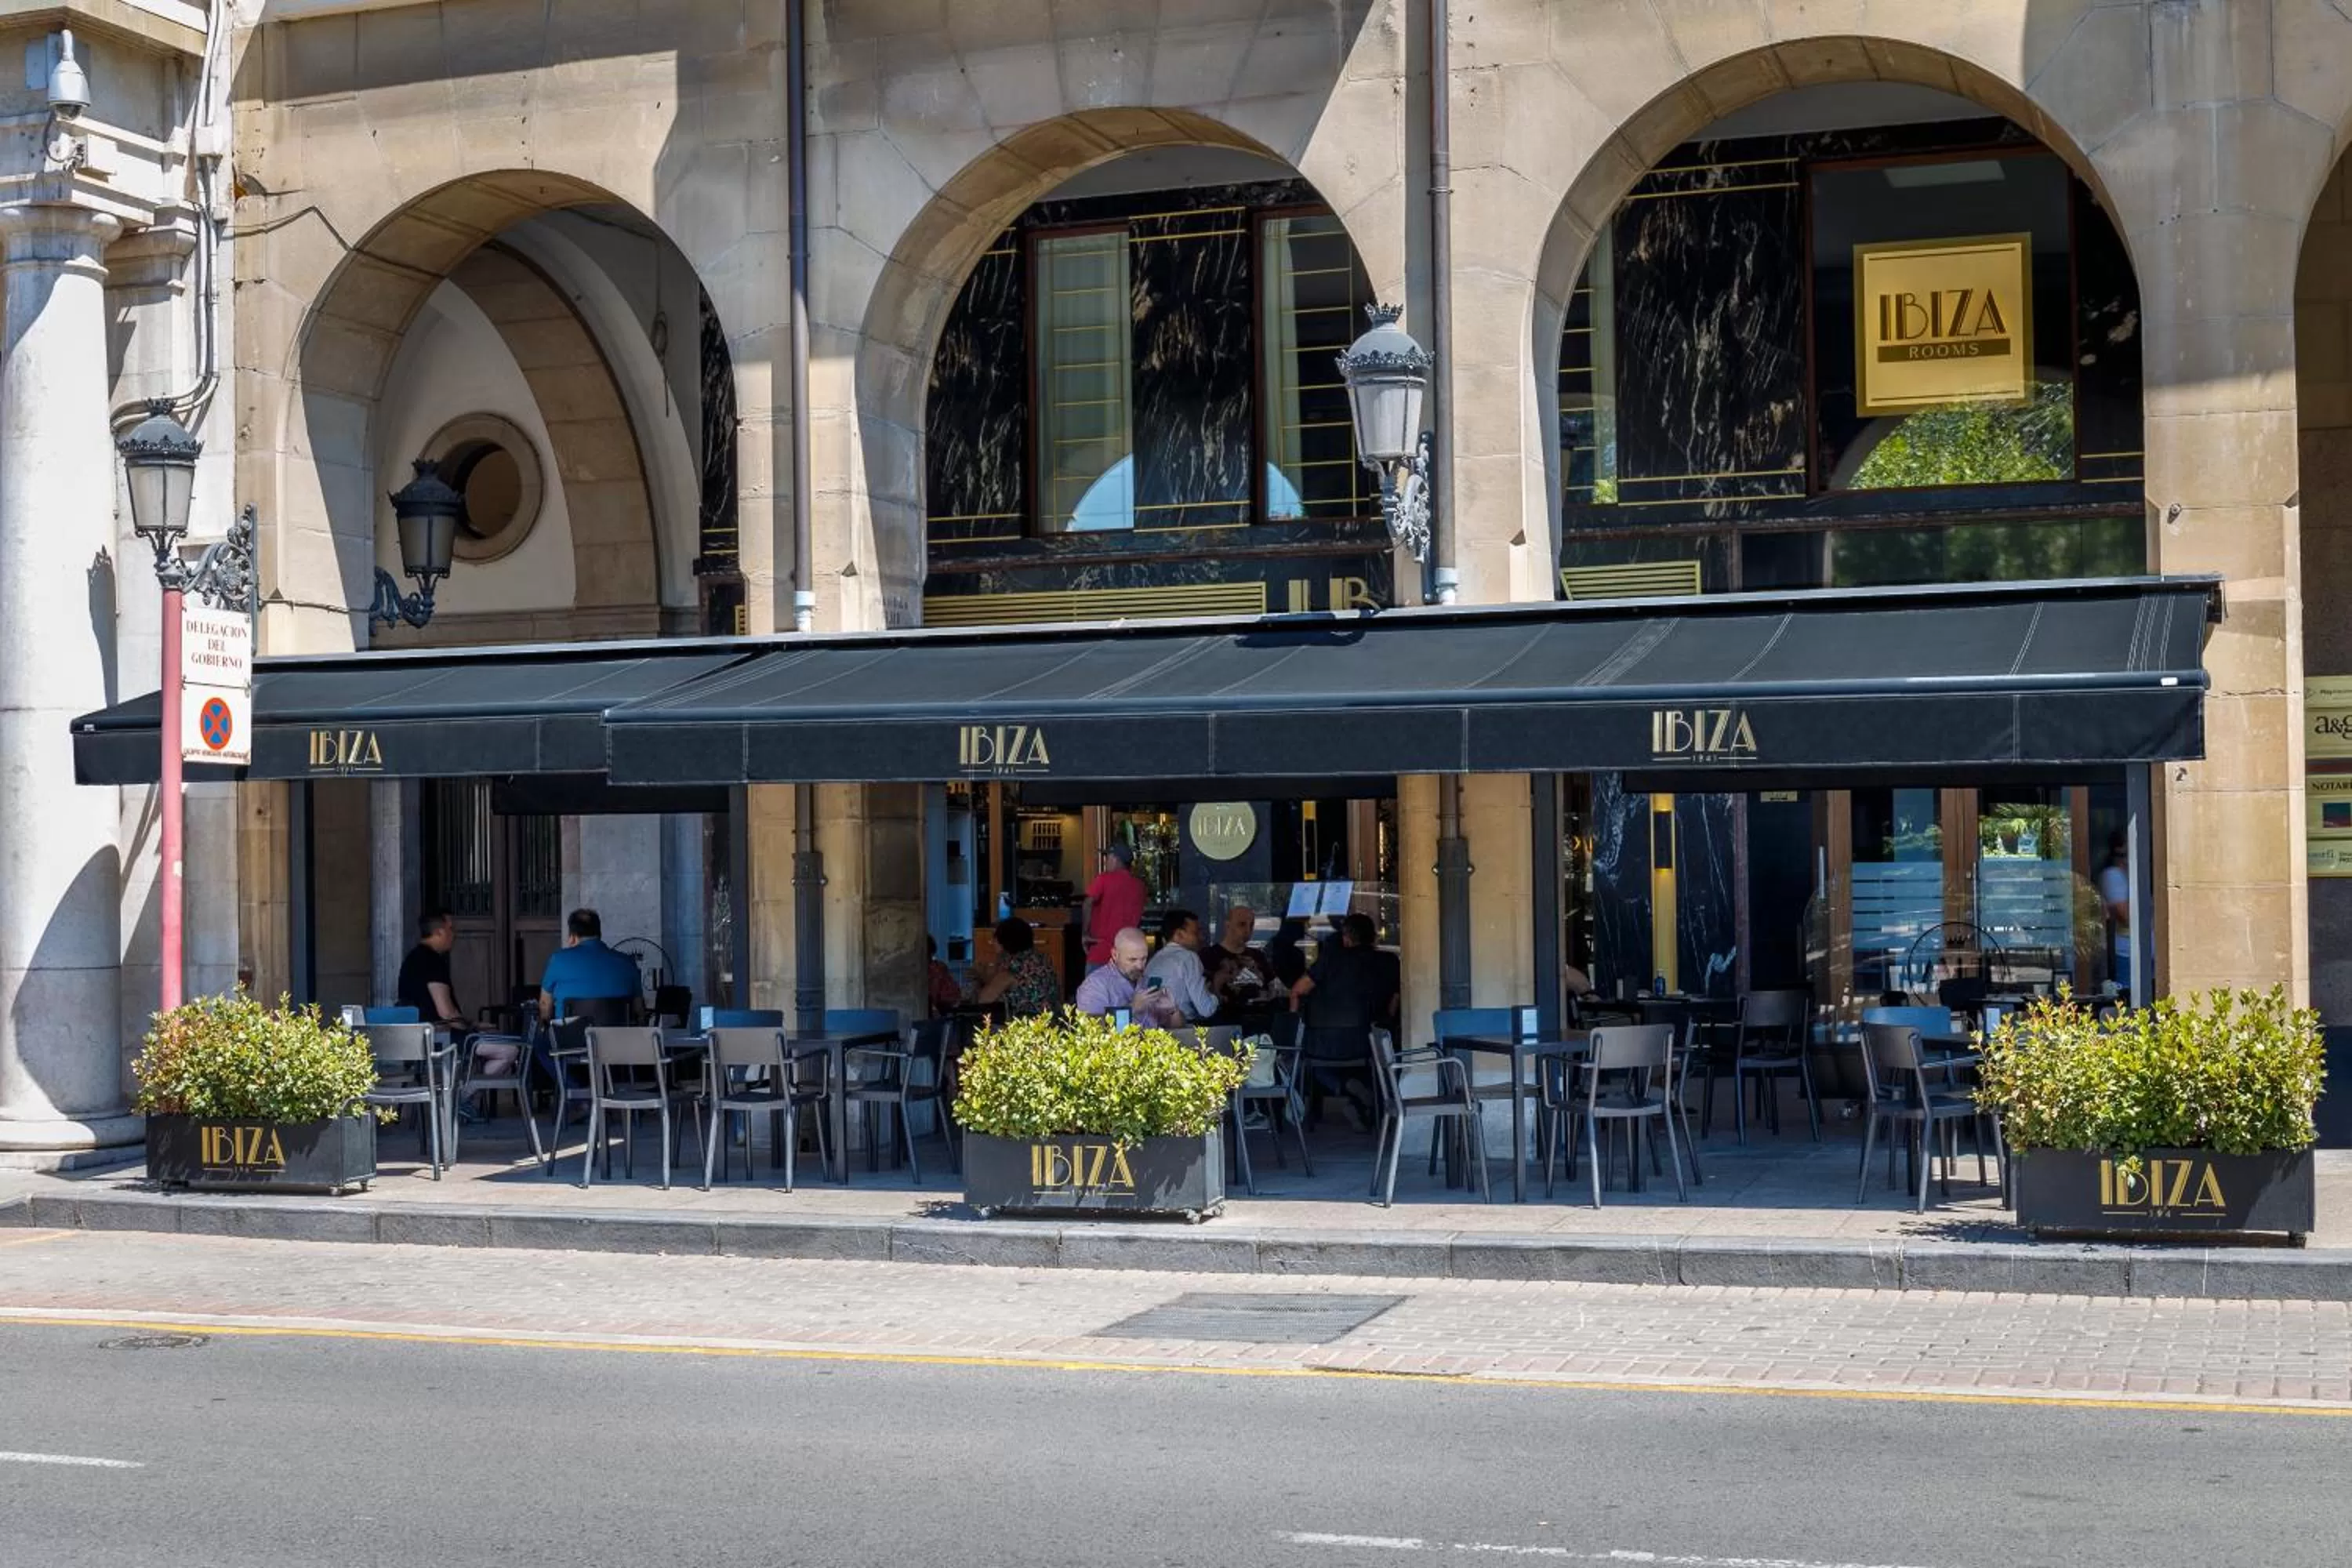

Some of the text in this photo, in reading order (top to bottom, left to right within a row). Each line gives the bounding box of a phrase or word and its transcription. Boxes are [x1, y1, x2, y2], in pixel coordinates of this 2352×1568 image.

[1879, 289, 2007, 341] IBIZA
[1908, 343, 1980, 359] ROOMS
[191, 652, 243, 669] GOBIERNO
[208, 638, 226, 652] DEL
[310, 730, 383, 765] IBIZA
[959, 725, 1051, 765] IBIZA
[1652, 710, 1757, 753] IBIZA
[201, 1127, 286, 1166] IBIZA
[1031, 1145, 1134, 1188] IBIZA
[2100, 1160, 2227, 1207] IBIZA
